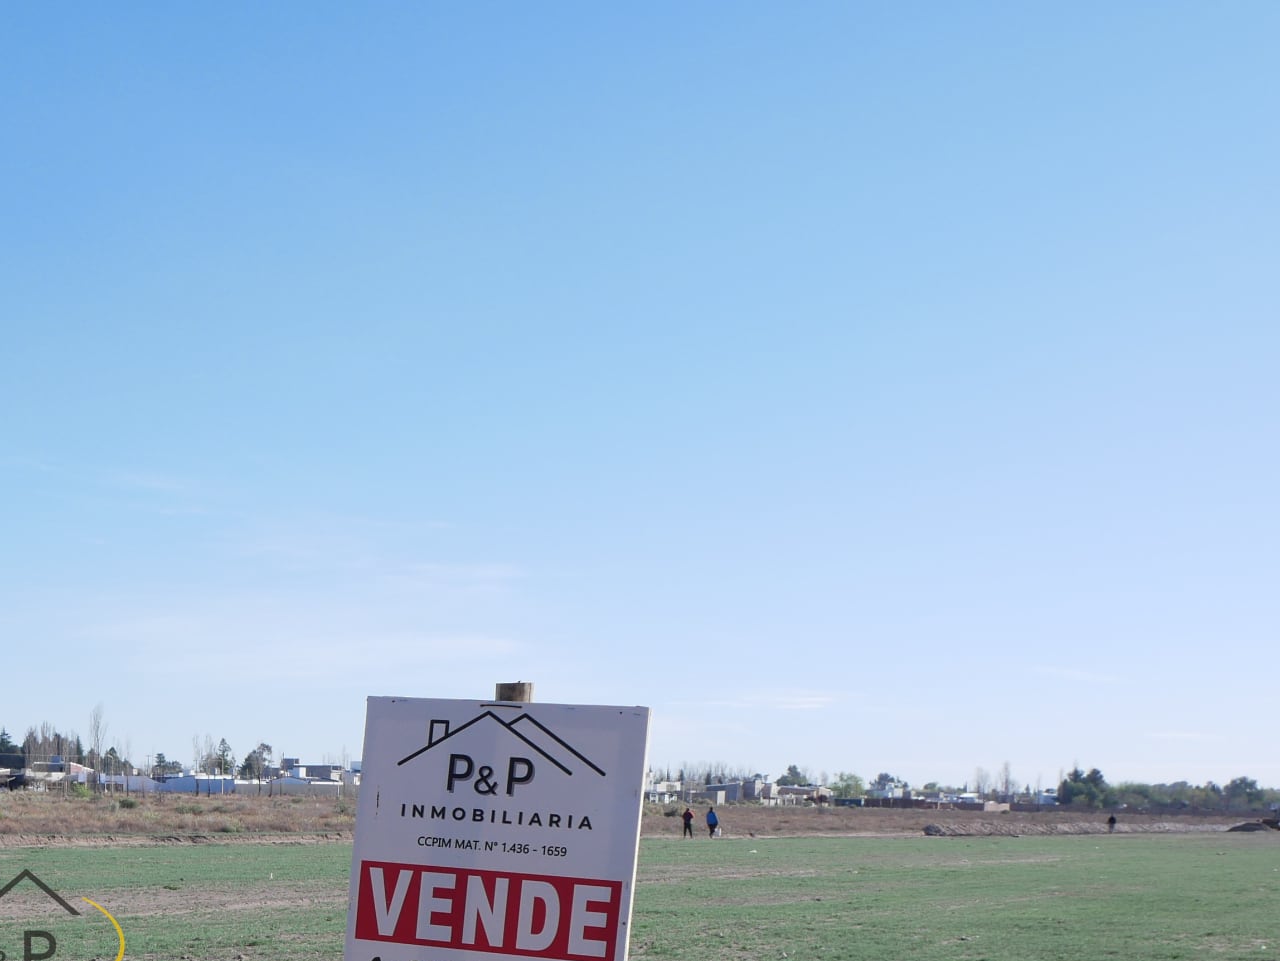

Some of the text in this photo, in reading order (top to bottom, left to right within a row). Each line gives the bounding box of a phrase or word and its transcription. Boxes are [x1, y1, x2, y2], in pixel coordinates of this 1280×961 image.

[446, 753, 535, 796] P&P
[400, 803, 593, 830] INMOBILIARIA
[417, 836, 452, 849] CCPIM
[454, 838, 481, 850] MAT.
[501, 842, 529, 854] 1.436
[541, 845, 567, 857] 1659
[369, 867, 612, 958] VENDE
